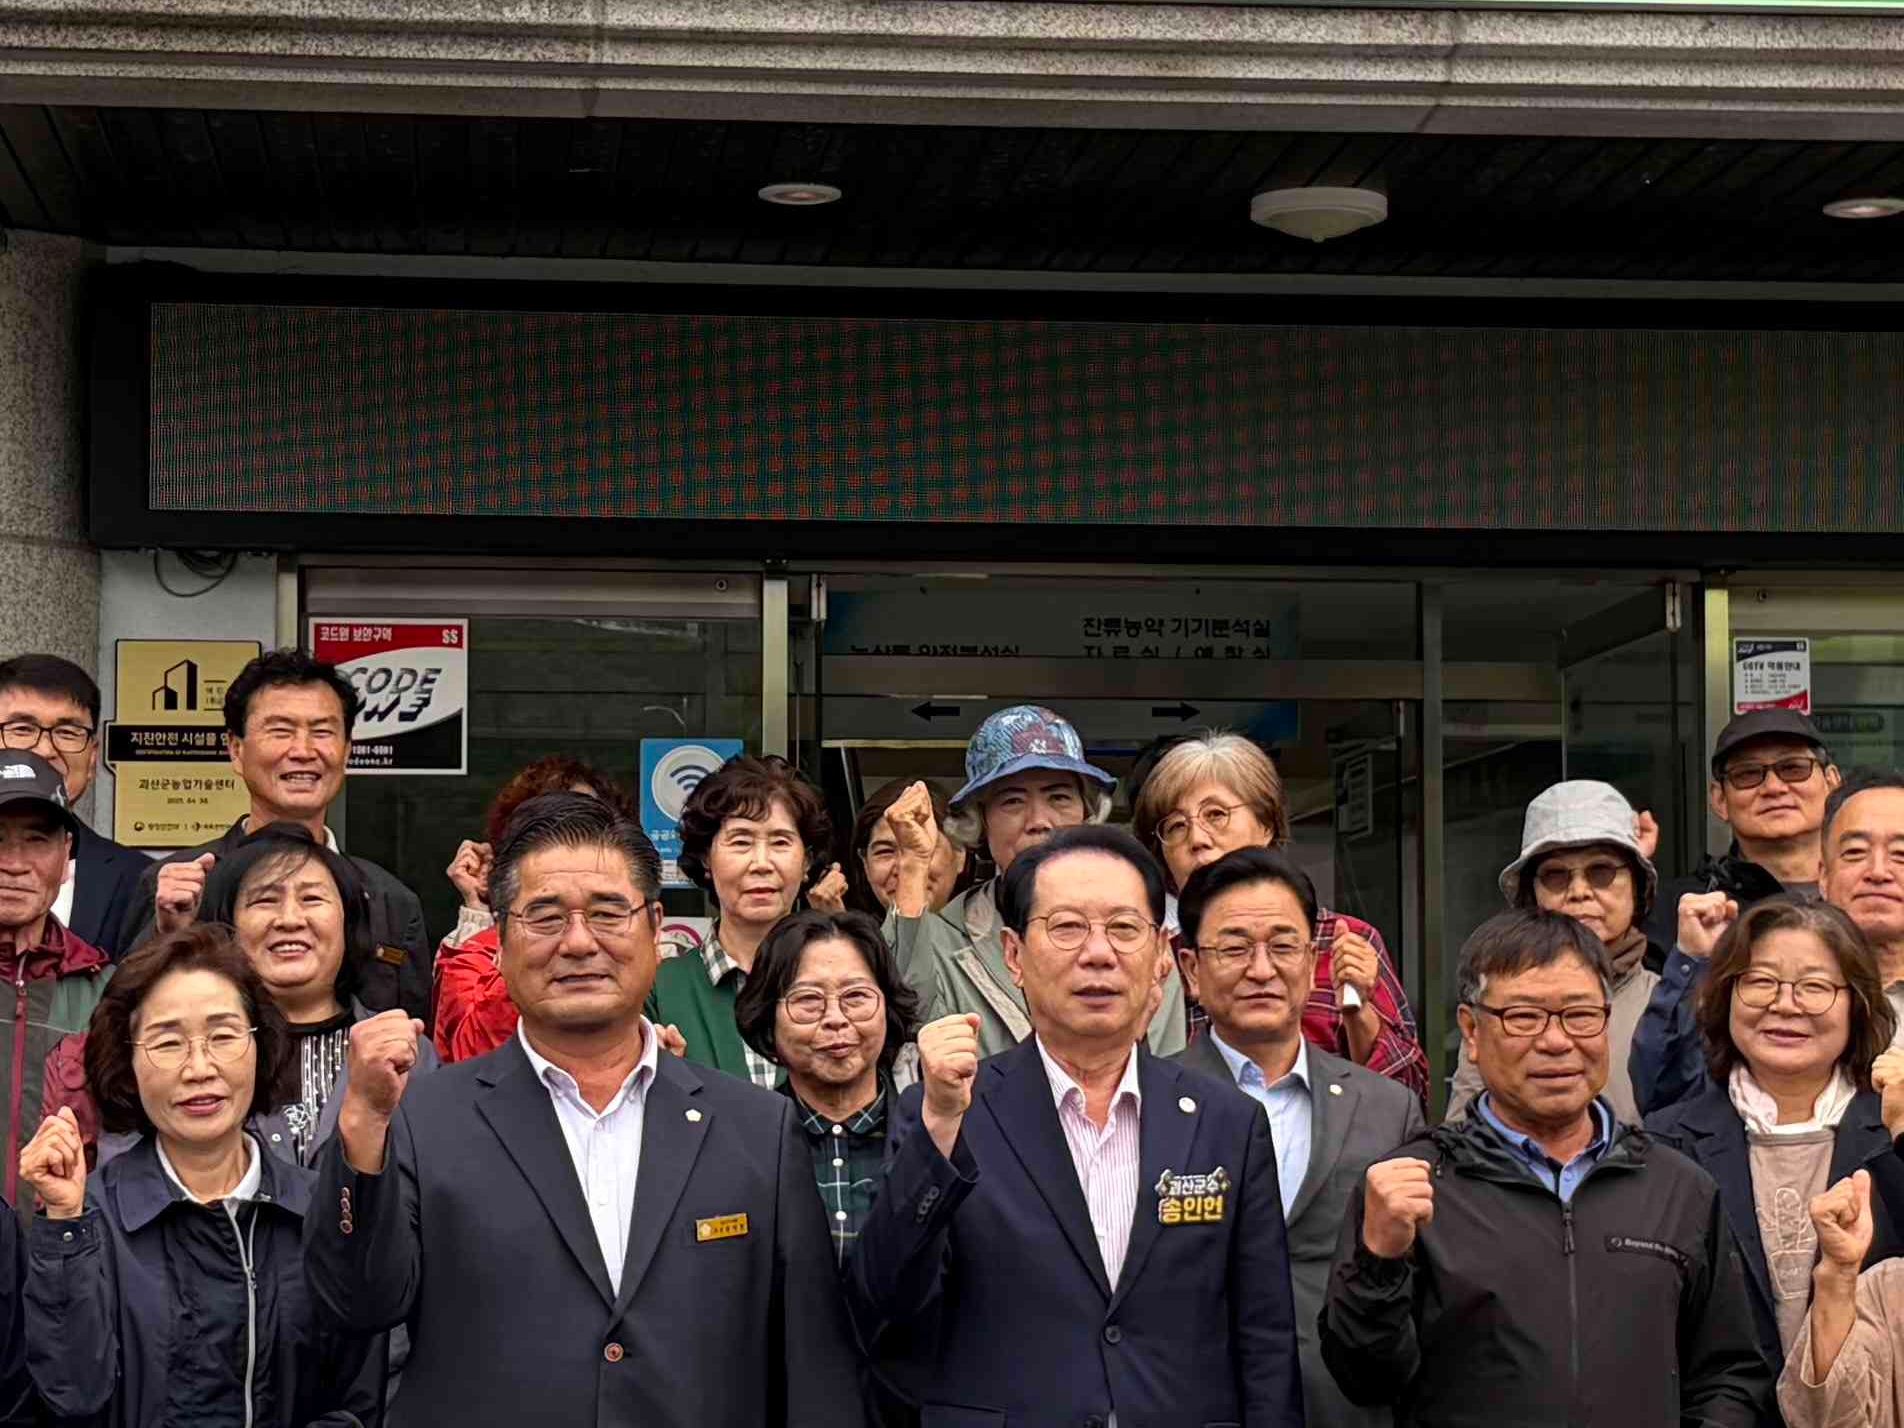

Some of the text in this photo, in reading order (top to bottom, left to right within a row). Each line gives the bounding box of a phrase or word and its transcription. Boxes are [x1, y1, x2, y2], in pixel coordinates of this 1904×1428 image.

[1081, 616, 1272, 640] 잔류농약 기기분석실
[131, 731, 178, 747] 지진안전
[181, 731, 217, 747] 시설물
[138, 778, 235, 791] 괴산군농업기술센터
